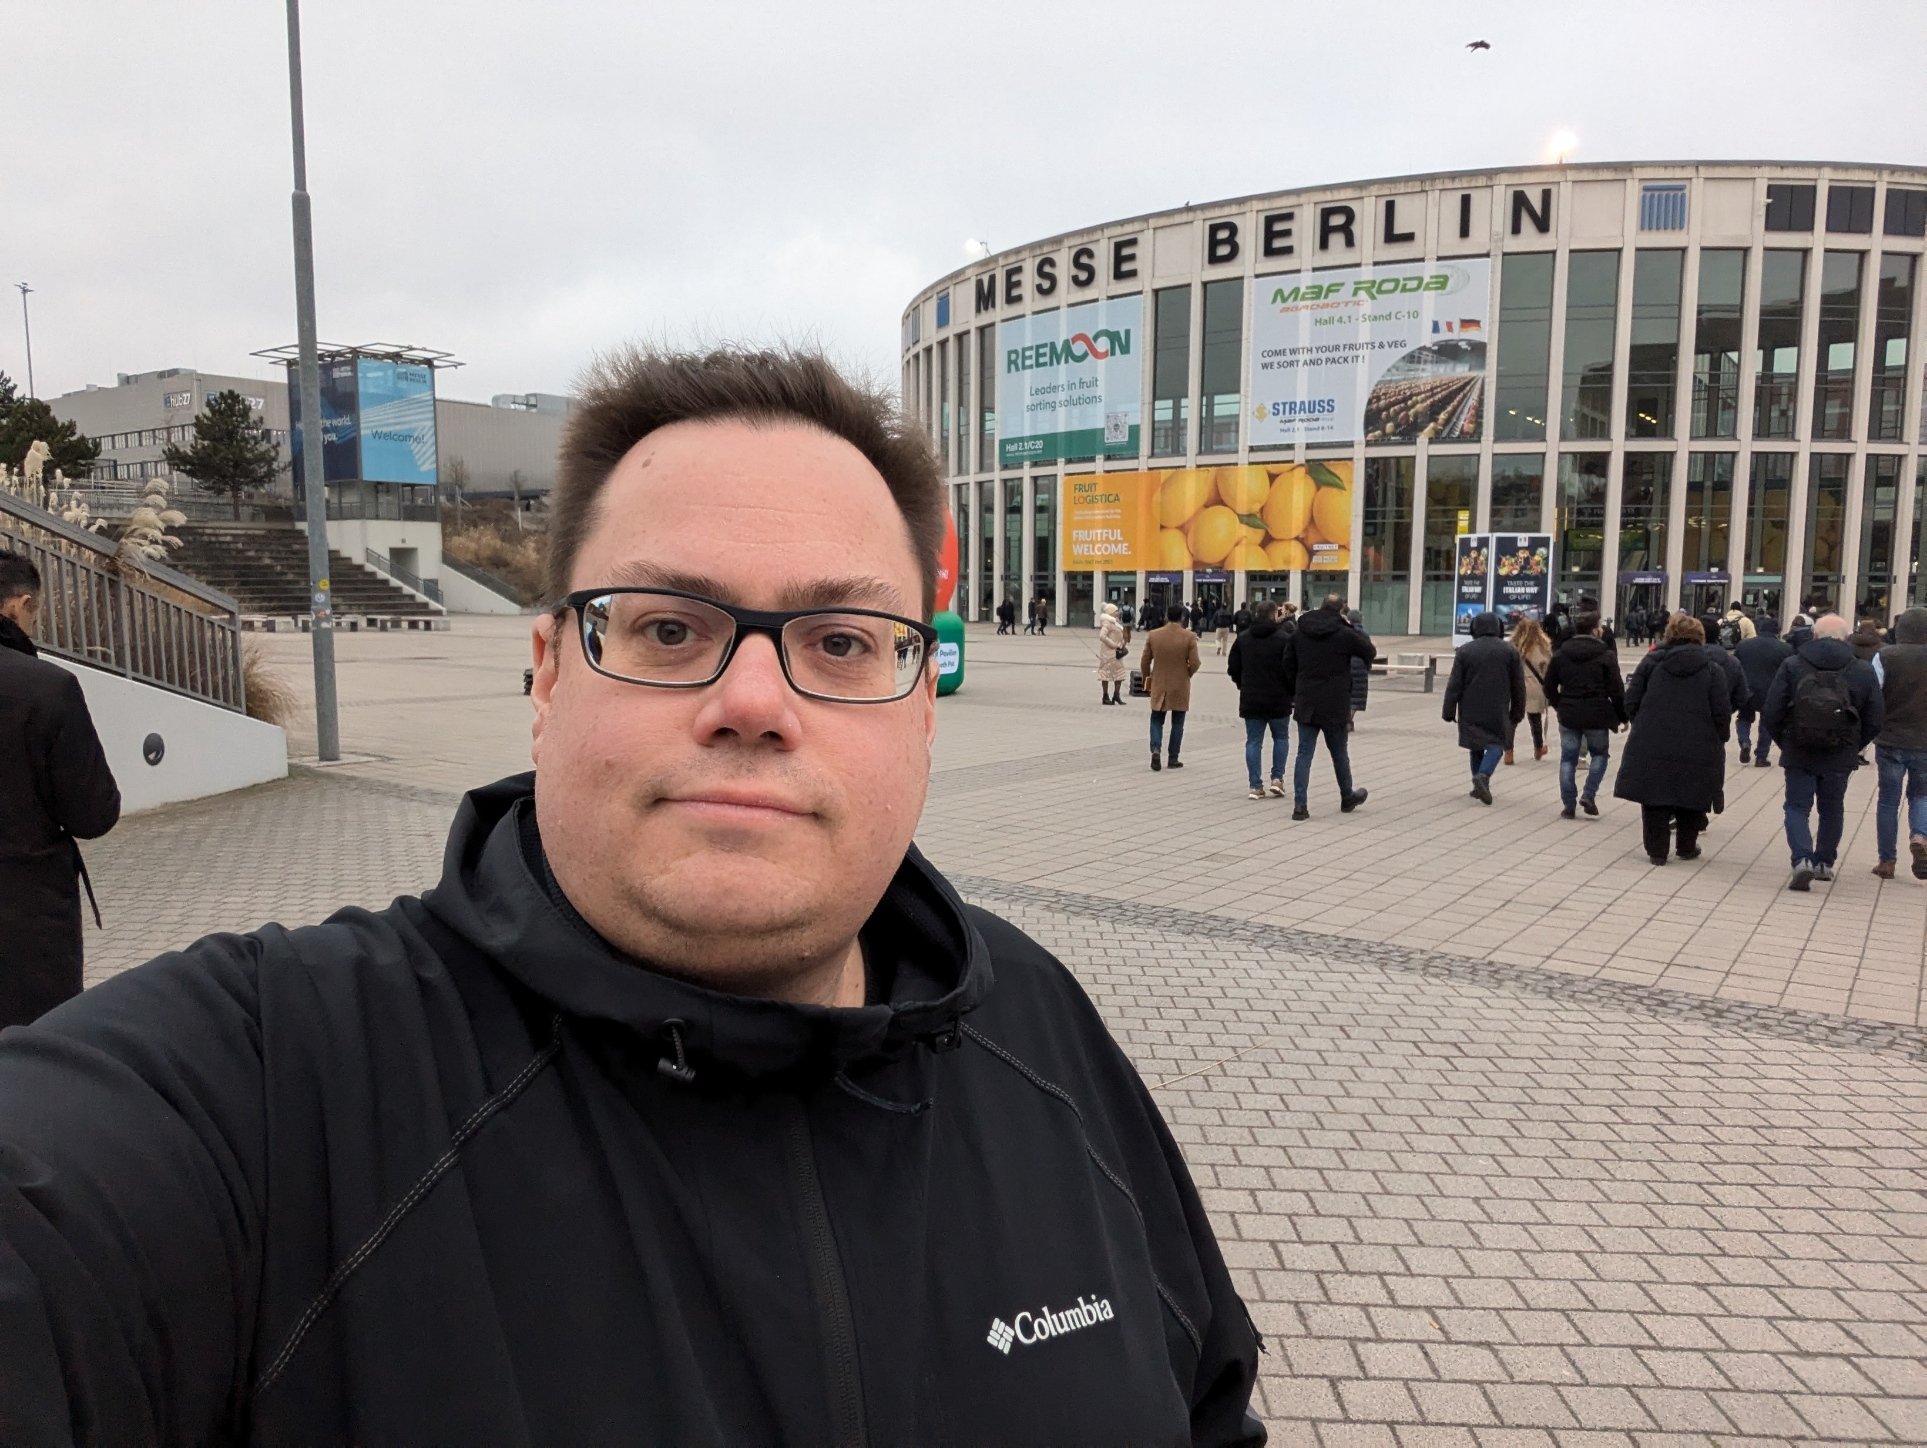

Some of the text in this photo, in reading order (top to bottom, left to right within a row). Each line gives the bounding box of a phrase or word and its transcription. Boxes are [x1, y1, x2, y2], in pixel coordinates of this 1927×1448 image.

[975, 188, 1552, 314] MESSE BERLIN
[1314, 316, 1335, 326] Hall
[1337, 315, 1352, 325] 4.1
[1361, 311, 1392, 323] Stand
[1395, 310, 1419, 320] C-10
[1007, 328, 1131, 374] REEMOON
[1261, 339, 1407, 358] COME WITH YOUR FRUITS & VEG
[1261, 361, 1275, 370] WE
[1276, 360, 1300, 370] SORT
[1302, 357, 1323, 367] AND
[1325, 355, 1350, 366] PACK
[1351, 355, 1361, 364] IT
[1029, 377, 1099, 397] Leaders in fruit
[1026, 394, 1103, 412] sorting solutions
[1272, 399, 1335, 416] STRAUSS
[371, 430, 425, 444] Welcome!
[1006, 442, 1018, 452] Hall
[1073, 483, 1097, 493] FRUIT
[1073, 493, 1120, 504] LOGISTICA
[1072, 529, 1123, 541] FRUITFUL
[1072, 543, 1131, 555] WELCOME.
[1015, 1294, 1114, 1344] Columbia
